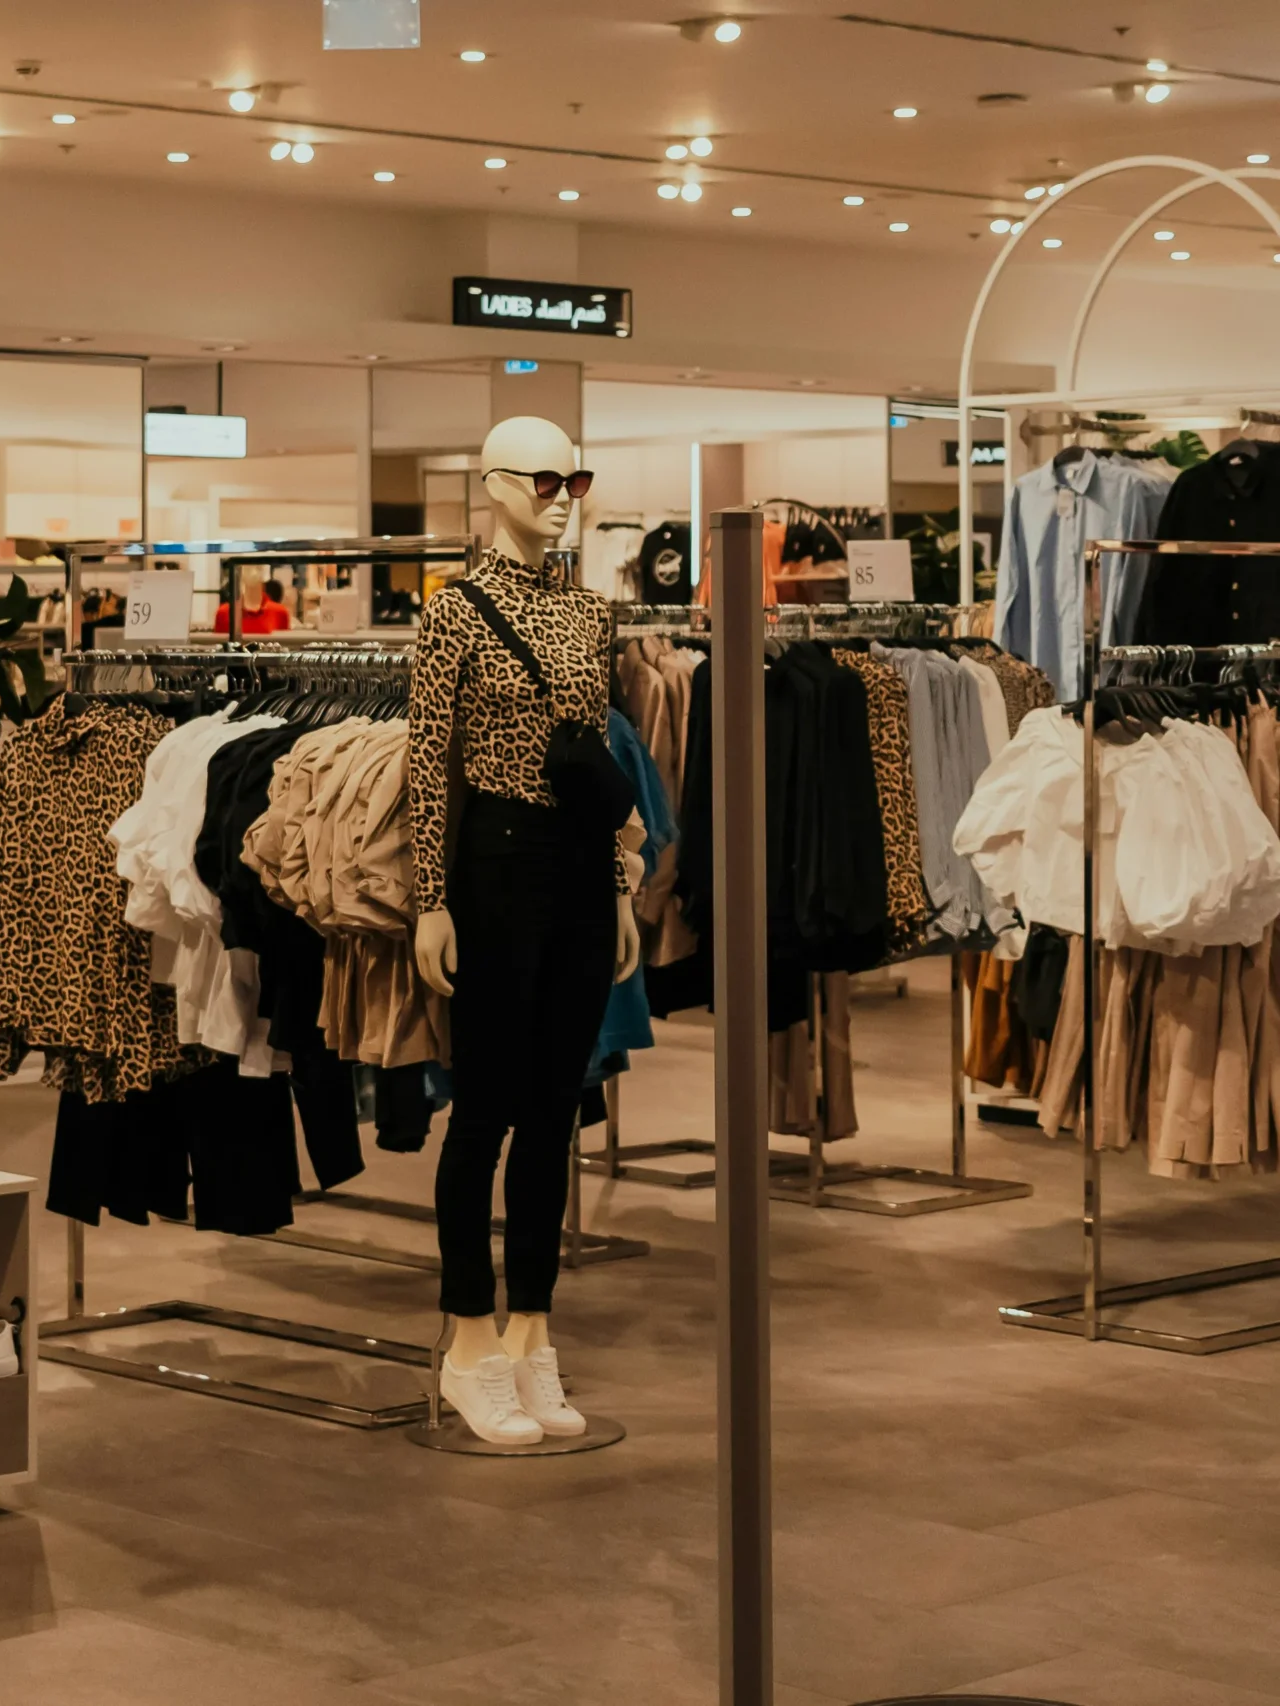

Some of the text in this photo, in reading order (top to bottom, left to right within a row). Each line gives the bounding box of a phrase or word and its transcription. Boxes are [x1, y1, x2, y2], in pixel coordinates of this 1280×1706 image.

[480, 294, 533, 318] LADIES
[855, 565, 875, 585] 85
[130, 602, 152, 625] 59
